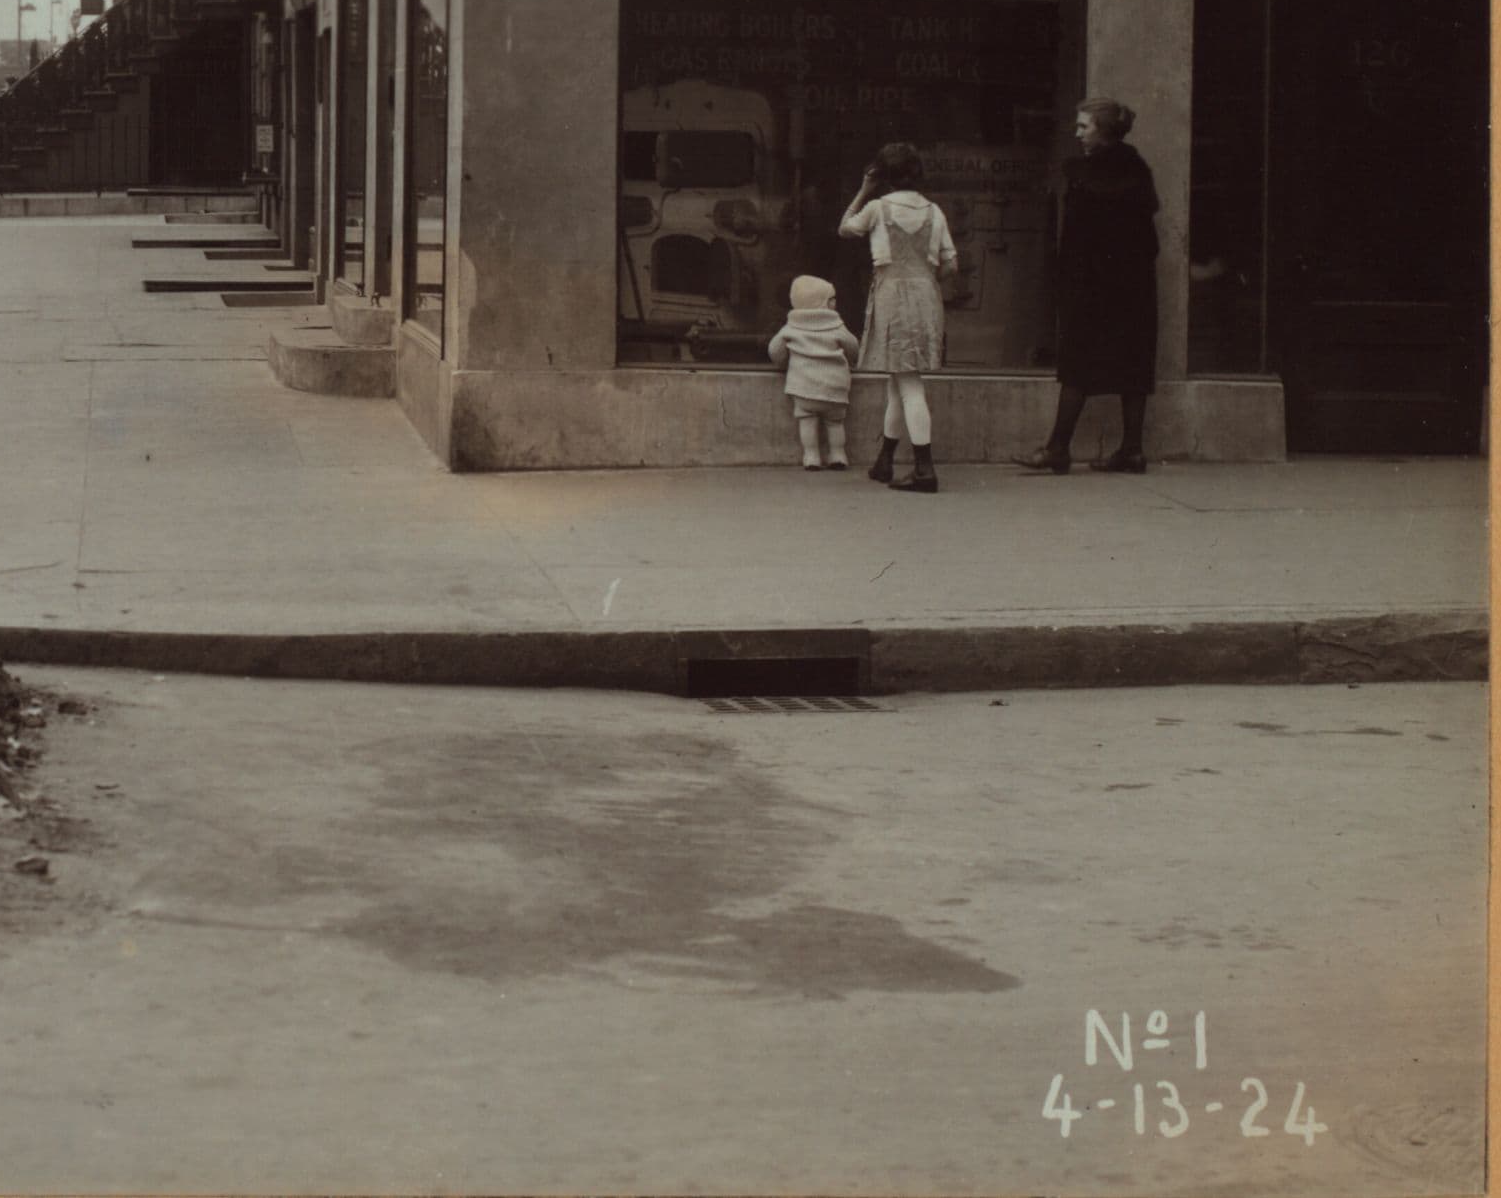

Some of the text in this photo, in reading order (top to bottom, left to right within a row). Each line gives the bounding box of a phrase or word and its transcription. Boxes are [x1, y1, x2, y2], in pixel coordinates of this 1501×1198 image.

[634, 10, 731, 39] HEATING
[889, 16, 950, 42] TANK
[659, 44, 709, 72] GAS
[896, 50, 954, 79] COAL
[923, 157, 1046, 174] ENERAL OFFIC
